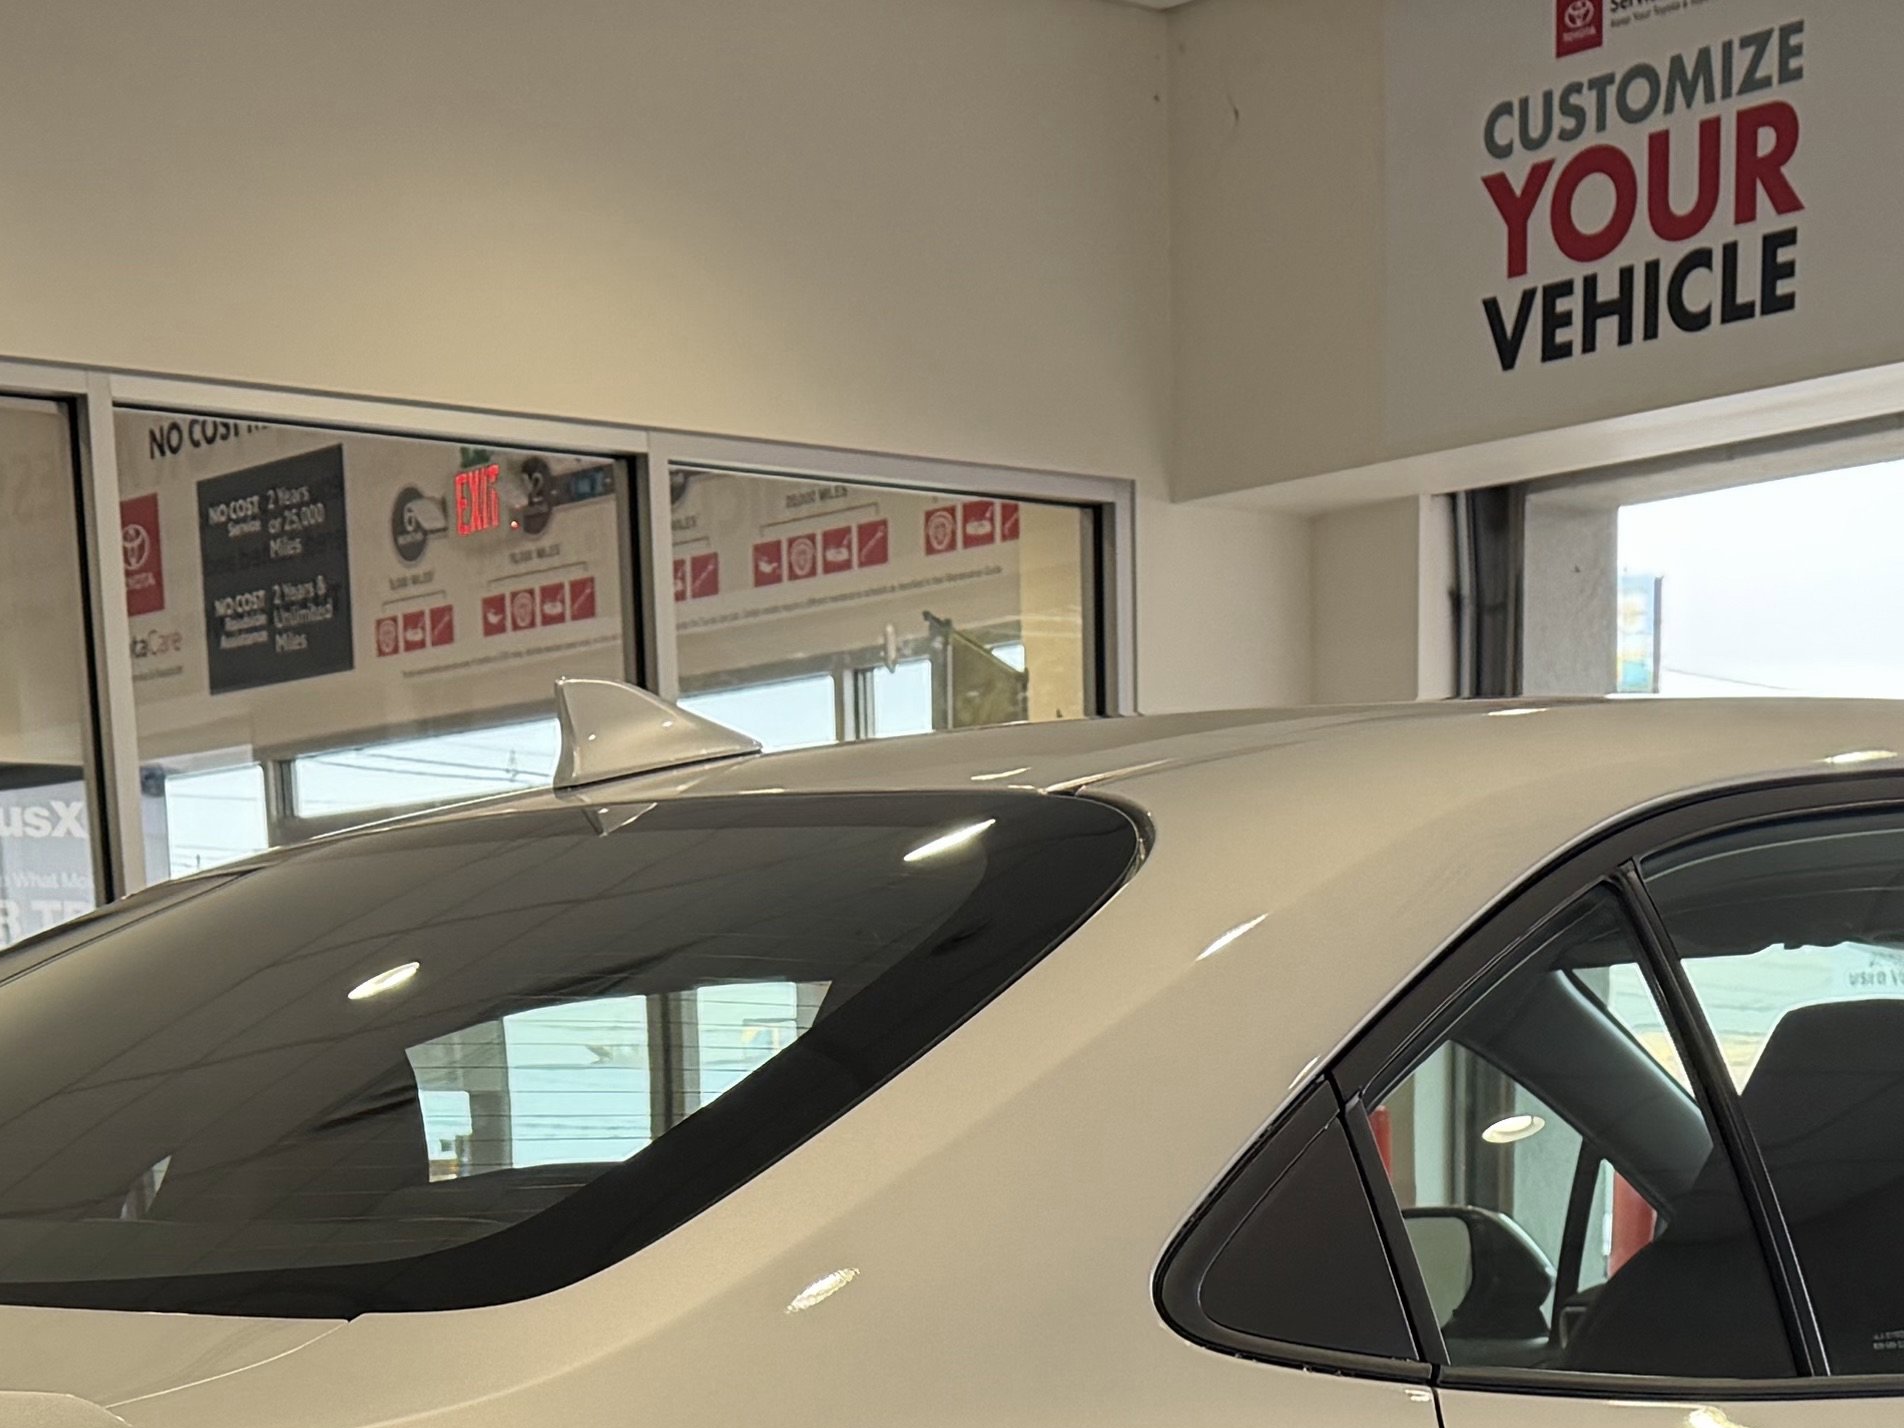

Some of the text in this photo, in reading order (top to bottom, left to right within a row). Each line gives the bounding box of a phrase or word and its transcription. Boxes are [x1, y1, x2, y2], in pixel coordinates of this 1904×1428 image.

[1483, 19, 1805, 160] CUSTOMIZE
[1480, 99, 1806, 279] YOUR
[1481, 226, 1799, 372] VEHICLE
[148, 421, 184, 460] NO
[208, 494, 261, 525] NO COST
[266, 484, 311, 510] 2 Years
[453, 463, 500, 538] EXIT
[268, 501, 327, 535] or 25,000
[269, 536, 304, 559] Miles
[213, 588, 267, 617] NO COST
[272, 583, 283, 604] 2
[283, 580, 315, 602] Years
[273, 598, 335, 629] Unlimited
[275, 632, 309, 653] Miles
